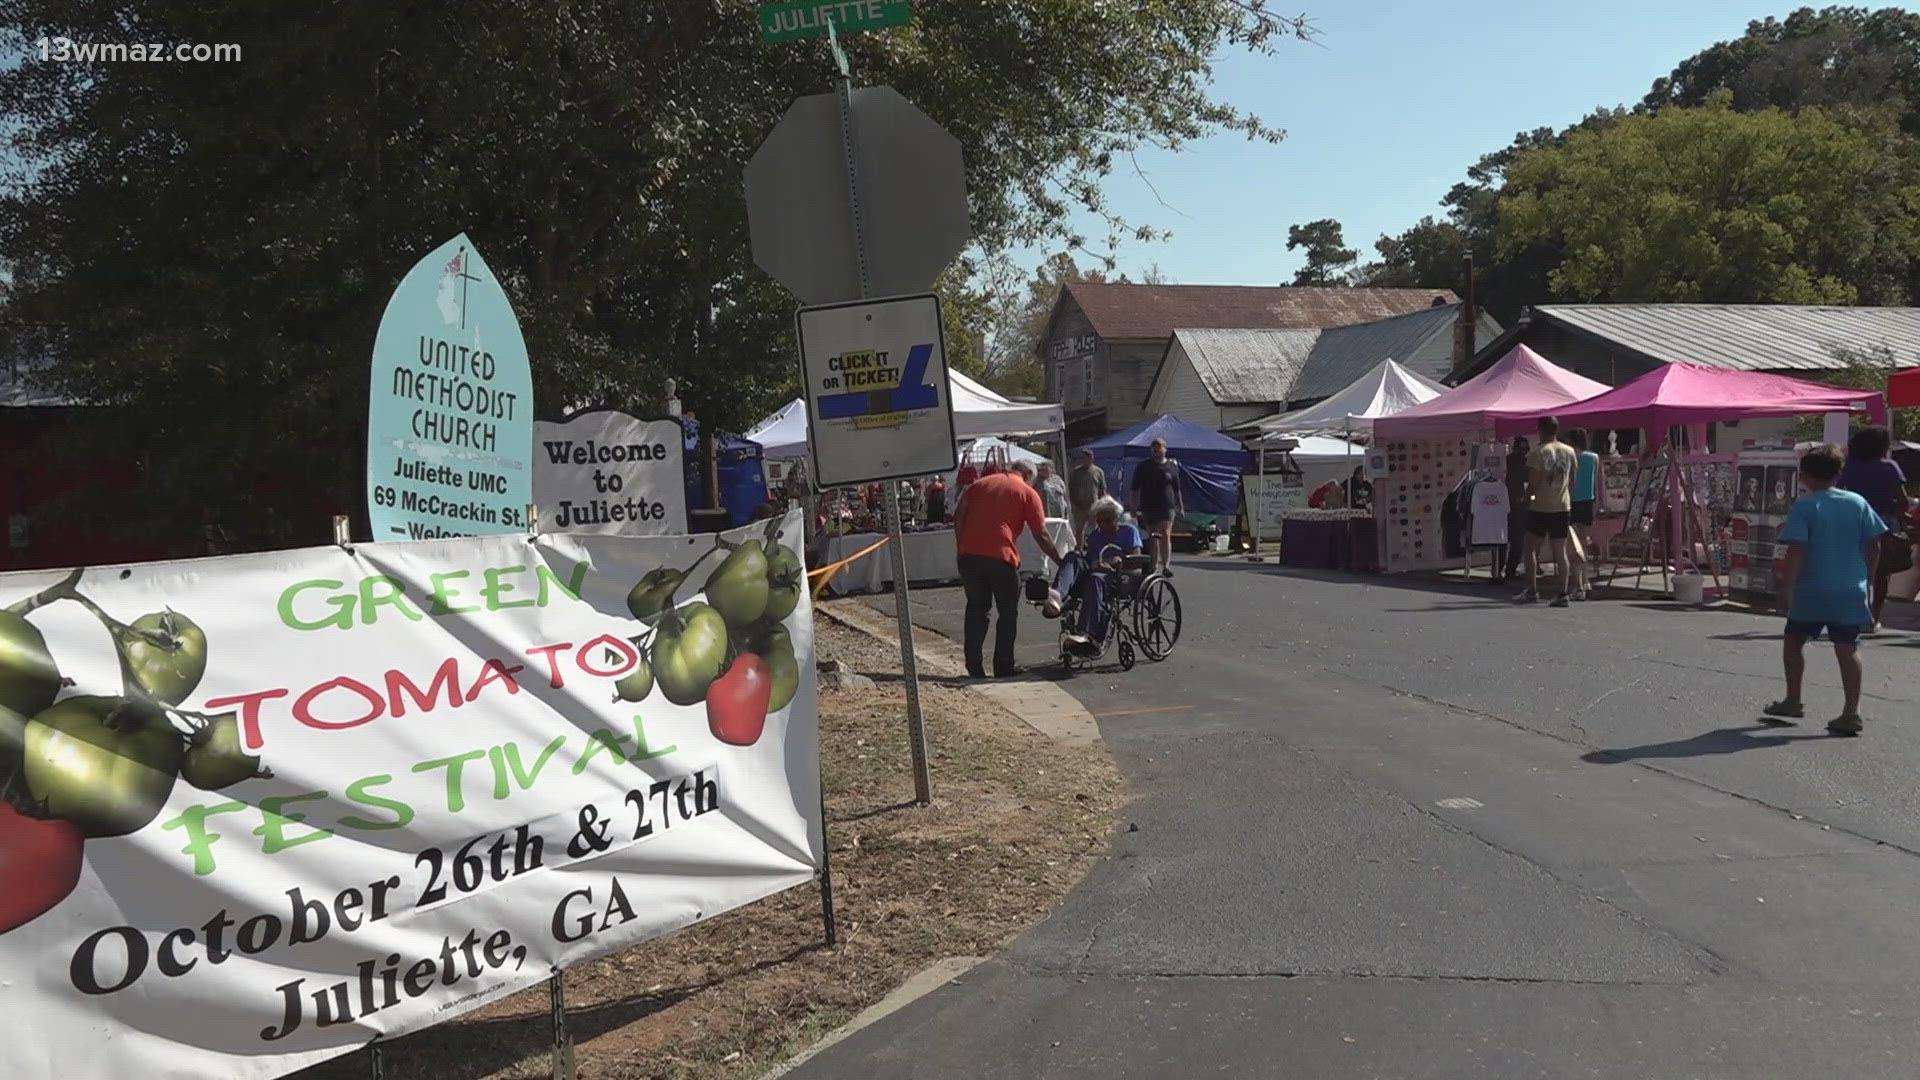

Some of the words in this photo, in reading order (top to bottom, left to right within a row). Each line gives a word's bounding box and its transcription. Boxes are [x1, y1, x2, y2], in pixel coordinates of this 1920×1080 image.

[768, 0, 884, 34] JULIETTE
[418, 335, 496, 381] UNITED
[823, 377, 840, 390] OR
[842, 368, 900, 387] TICKET!
[828, 353, 872, 372] CLICK
[874, 351, 889, 367] IT
[392, 366, 517, 421] METHODIST
[411, 408, 497, 453] CHURCH
[543, 440, 667, 465] Welcome
[393, 457, 463, 488] Juliette
[468, 472, 508, 495] UMC
[593, 469, 623, 493] to
[374, 486, 396, 507] 69
[401, 492, 497, 525] McCrackin
[501, 507, 526, 528] St.
[555, 497, 665, 528] Juliette
[279, 563, 590, 631] GREEN
[204, 634, 640, 750] TOMATO
[161, 714, 677, 877] FESTIVAL
[70, 872, 401, 996] October
[414, 822, 545, 908] 26th
[567, 802, 614, 858] &
[624, 768, 720, 841] 27th
[259, 925, 528, 1042] Juliette,
[550, 876, 639, 942] GA
